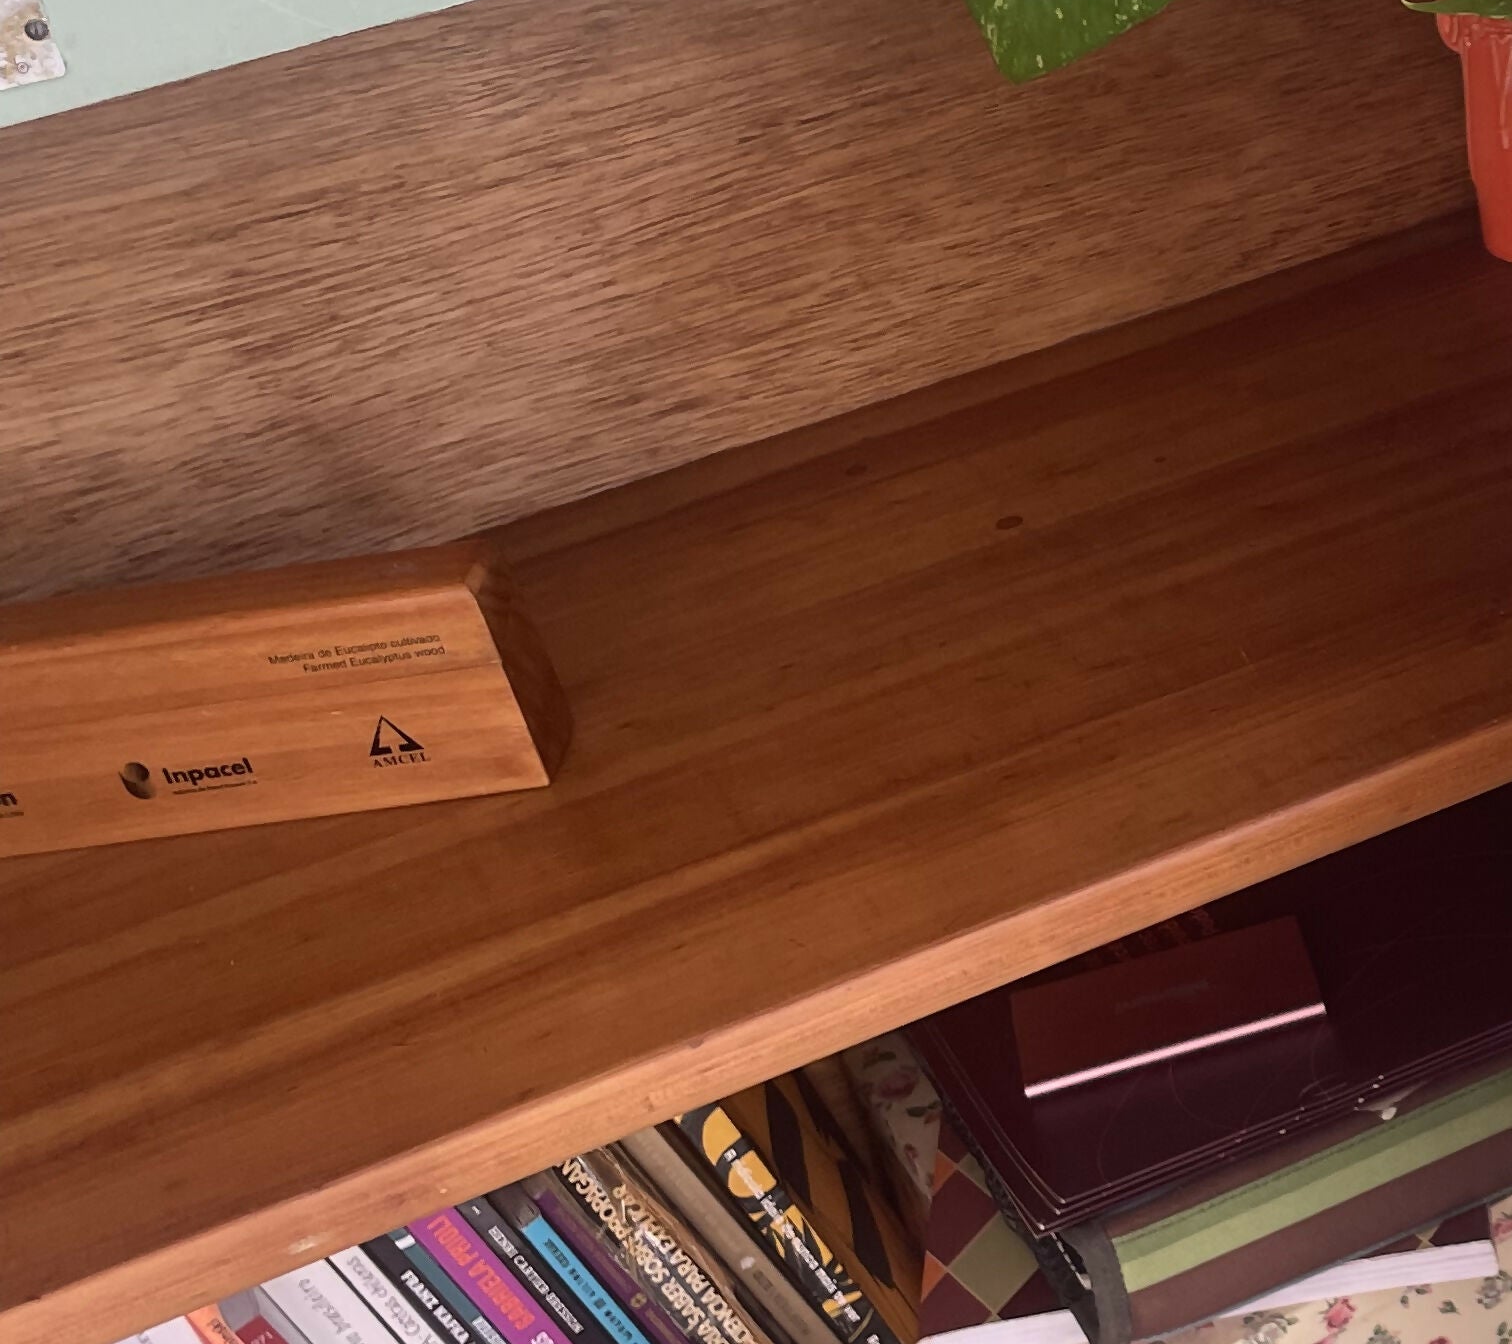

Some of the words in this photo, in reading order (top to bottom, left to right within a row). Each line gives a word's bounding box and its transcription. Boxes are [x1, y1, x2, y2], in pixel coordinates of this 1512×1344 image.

[267, 650, 314, 665] Madeira
[317, 648, 331, 658] de
[334, 640, 387, 656] Eucalipto
[390, 633, 440, 647] cultivado
[303, 658, 346, 672] Farmed
[349, 650, 412, 667] Eucalyptus
[414, 646, 445, 657] wood
[161, 756, 254, 788] Inpacel
[372, 753, 431, 770] AMCEL
[423, 1212, 479, 1269] PRIOLI
[398, 1268, 440, 1311] FRANZ
[666, 1245, 711, 1295] PARA
[292, 1274, 351, 1337] brasileiro
[380, 1294, 423, 1339] Cartas
[464, 1258, 537, 1333] GABRIELA
[659, 1274, 707, 1328] SABER
